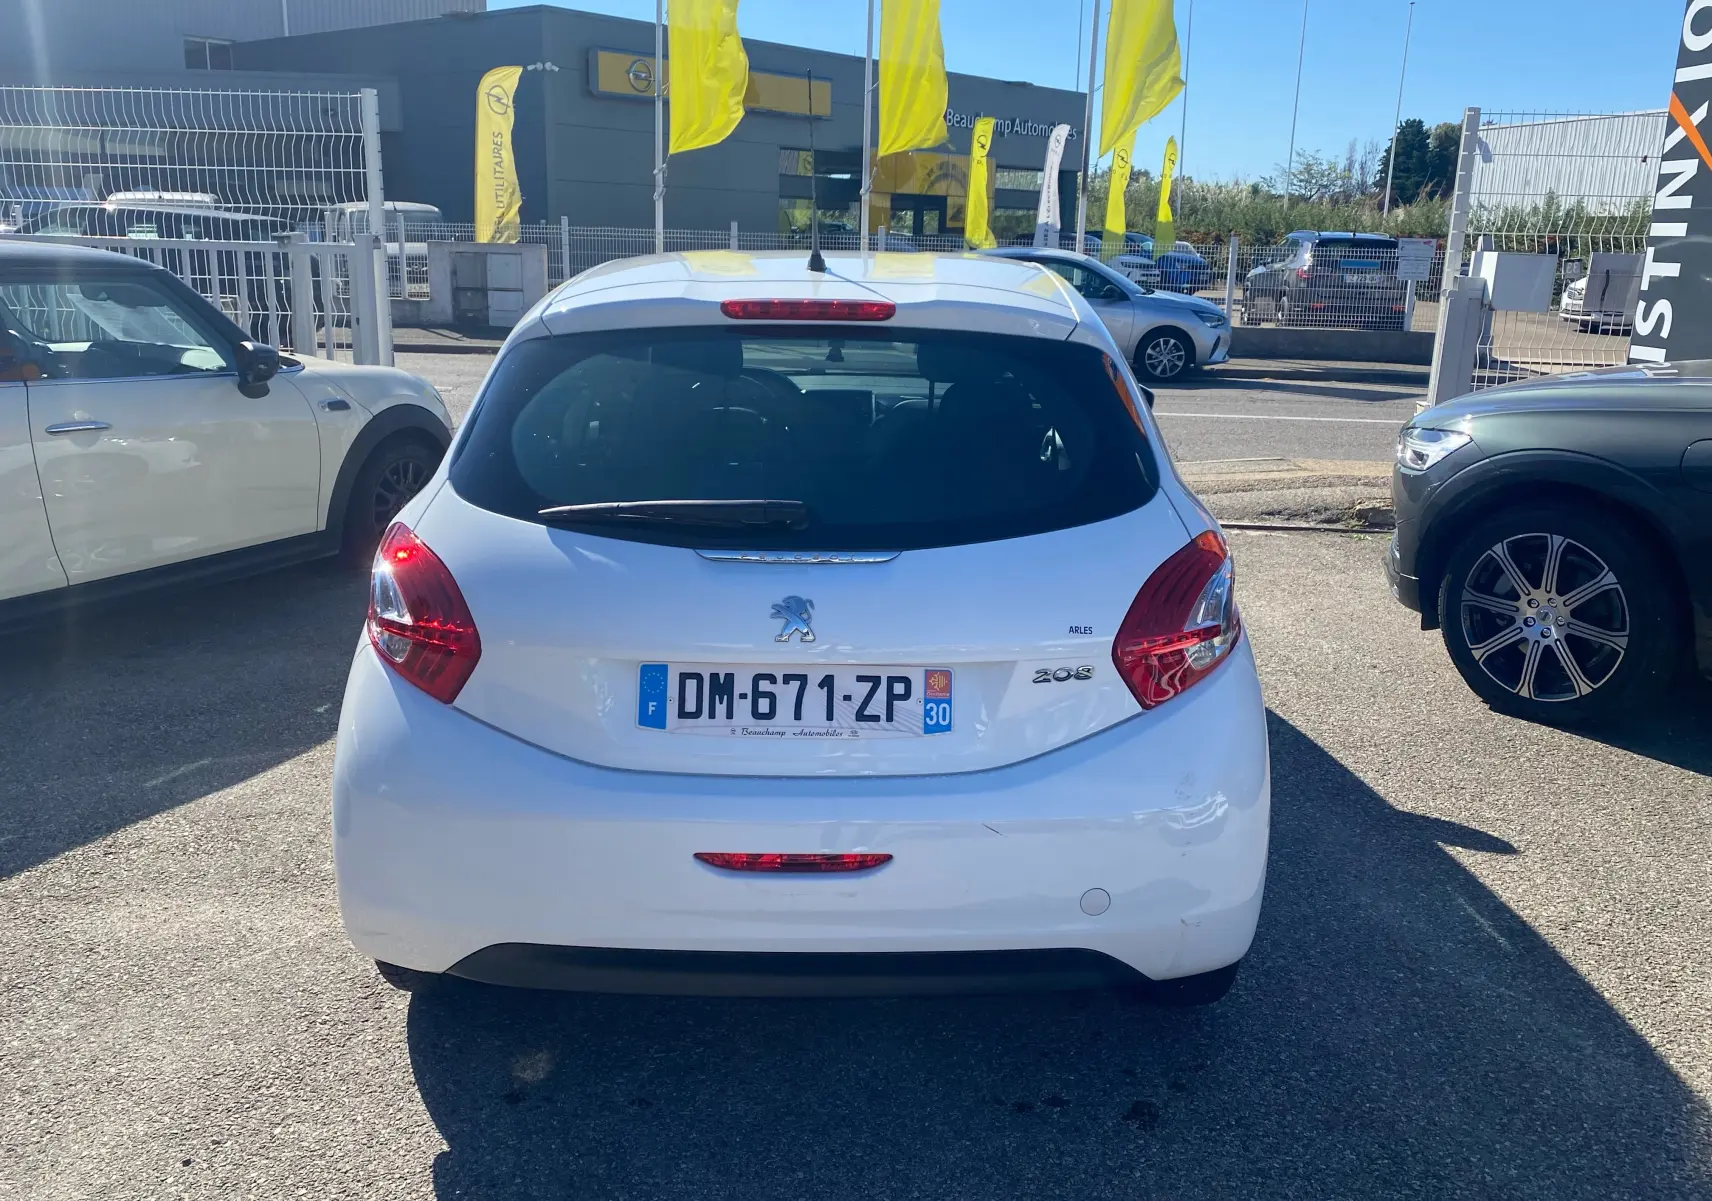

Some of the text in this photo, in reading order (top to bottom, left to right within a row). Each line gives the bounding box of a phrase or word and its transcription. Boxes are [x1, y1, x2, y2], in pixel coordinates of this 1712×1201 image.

[947, 108, 1077, 140] Beaump Automoes
[492, 131, 505, 209] UTILITAIRES
[1068, 625, 1093, 635] ARLES
[1032, 664, 1095, 684] 208
[648, 701, 658, 715] F
[677, 671, 912, 723] DM-671-ZP
[925, 702, 950, 726] 30
[741, 727, 844, 738] Beauchamp Automobiles
